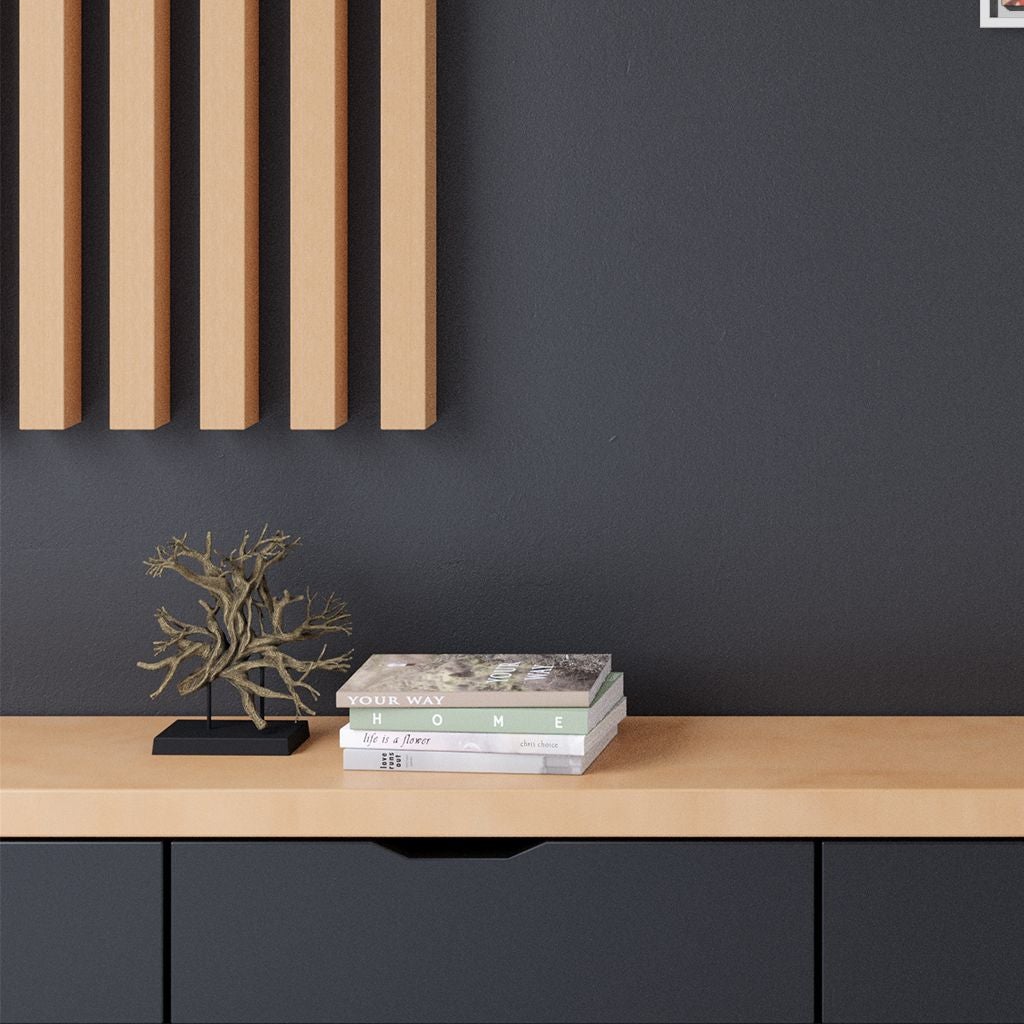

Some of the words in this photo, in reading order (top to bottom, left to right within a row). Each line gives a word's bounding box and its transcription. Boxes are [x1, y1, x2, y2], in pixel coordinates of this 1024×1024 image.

[348, 696, 400, 705] YOUR
[406, 696, 445, 705] WAY
[372, 712, 563, 728] HOME
[363, 733, 379, 747] life
[381, 735, 389, 744] is
[400, 734, 431, 748] flower
[520, 739, 536, 747] chris
[537, 740, 559, 748] choice
[380, 752, 388, 769] love
